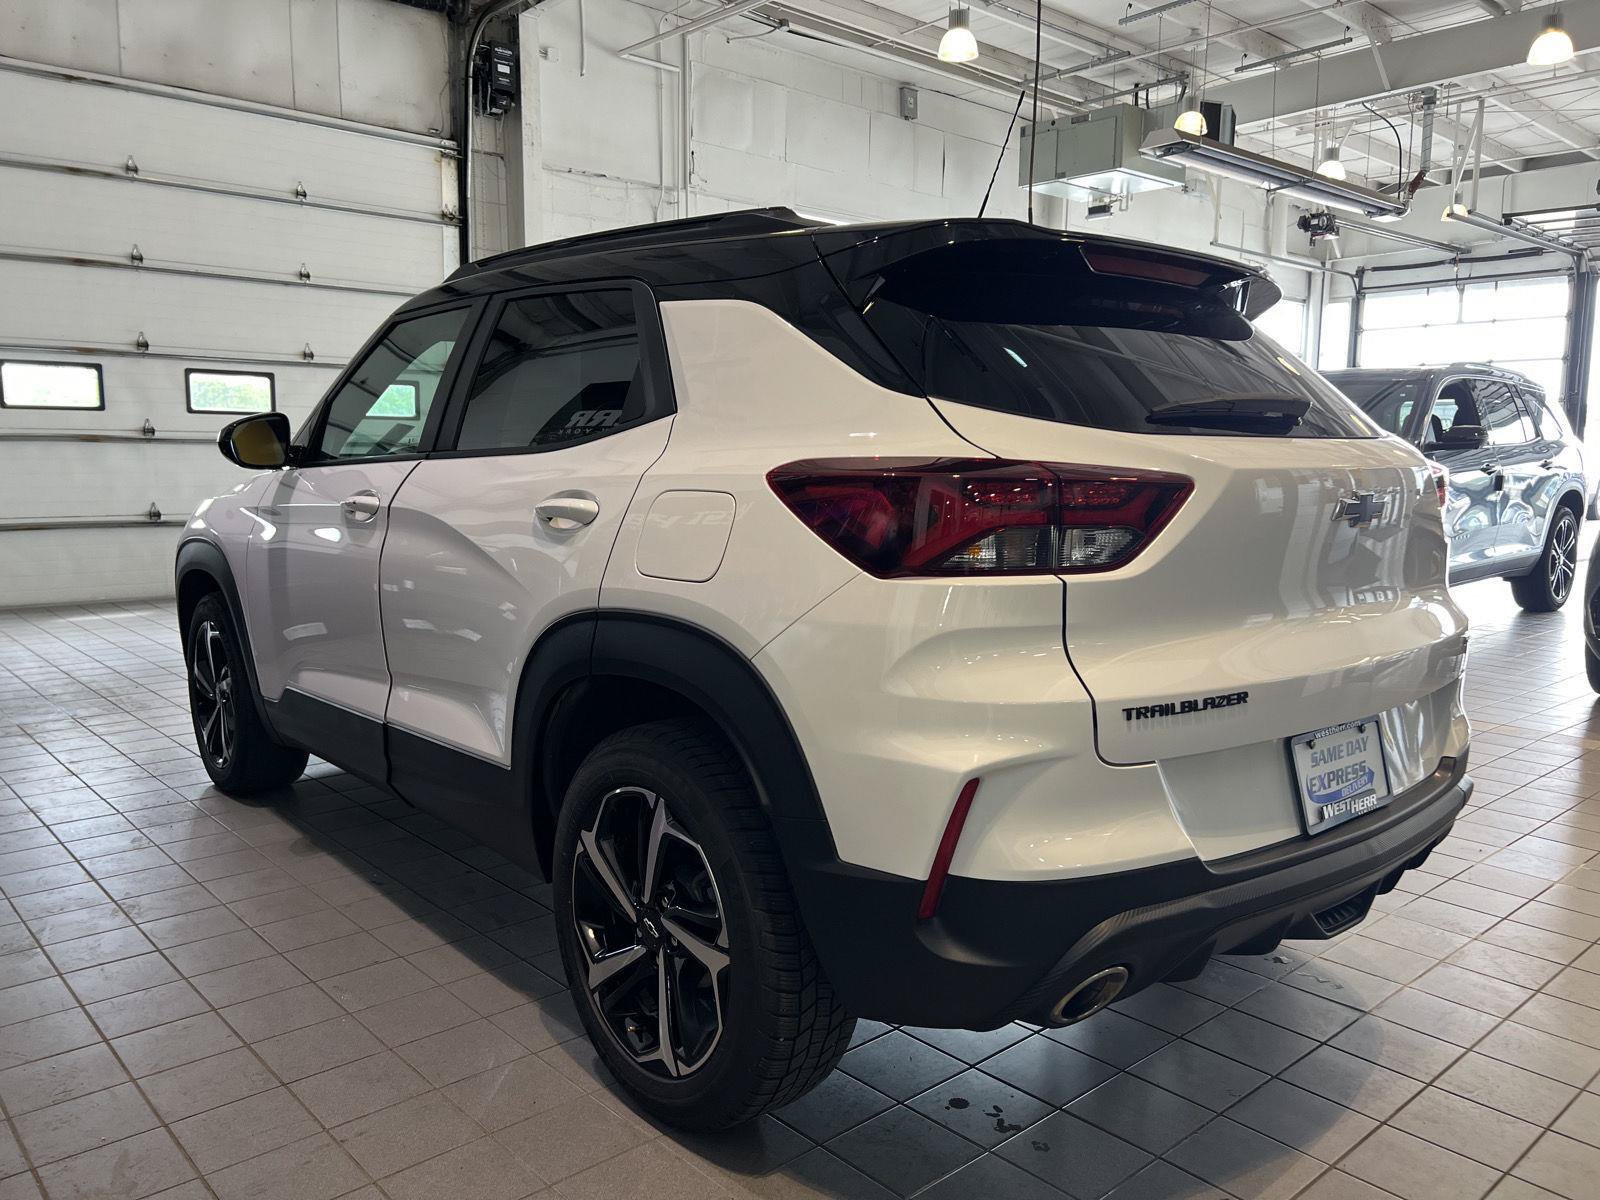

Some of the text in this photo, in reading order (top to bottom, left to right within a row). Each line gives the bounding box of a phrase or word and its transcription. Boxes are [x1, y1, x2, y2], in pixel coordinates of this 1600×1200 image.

[1122, 691, 1249, 721] TRAILBLAZER
[1311, 736, 1369, 768] SAME DAY
[1309, 760, 1368, 793] EXPRESS
